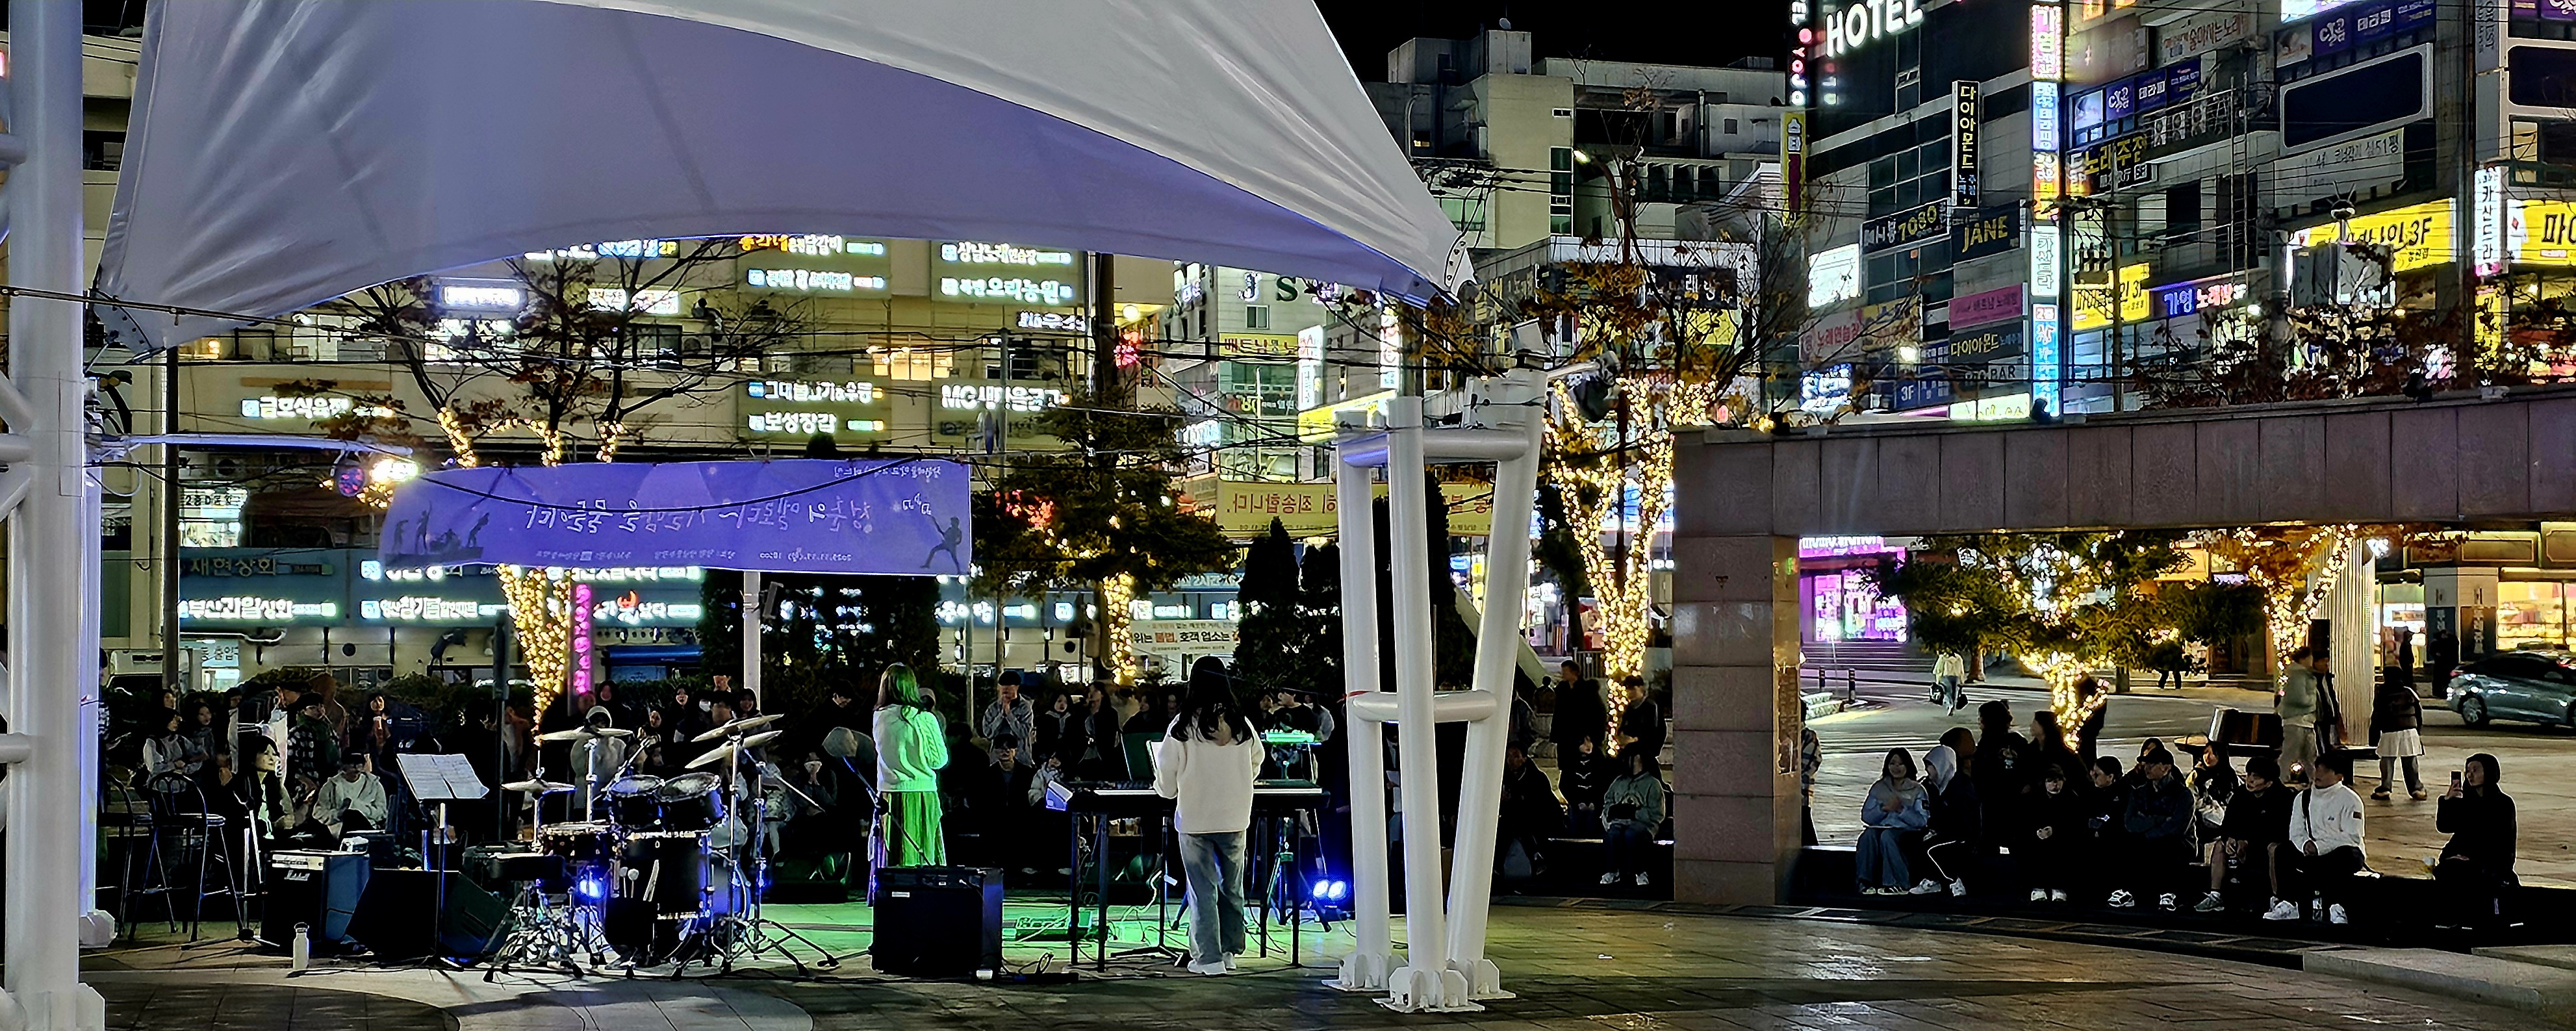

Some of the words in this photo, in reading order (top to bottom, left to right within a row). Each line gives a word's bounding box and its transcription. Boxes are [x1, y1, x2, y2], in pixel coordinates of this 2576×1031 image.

[1826, 0, 1923, 57] HOTEL
[2358, 9, 2391, 31] 테라피
[2139, 81, 2165, 99] 테라피
[1960, 85, 1976, 168] 다이아몬드
[2084, 135, 2147, 175] 노래주점
[1898, 205, 1937, 241] 7080
[1962, 215, 2009, 253] JANE
[2408, 216, 2432, 246] 3F
[2164, 288, 2194, 316] 가영
[1950, 333, 1999, 357] 다이아몬드
[1901, 385, 1915, 401] 3F
[190, 557, 277, 576] 재현상회
[1155, 632, 1178, 643] 불법.
[1179, 631, 1200, 643] 호객
[1201, 631, 1230, 643] 업소는
